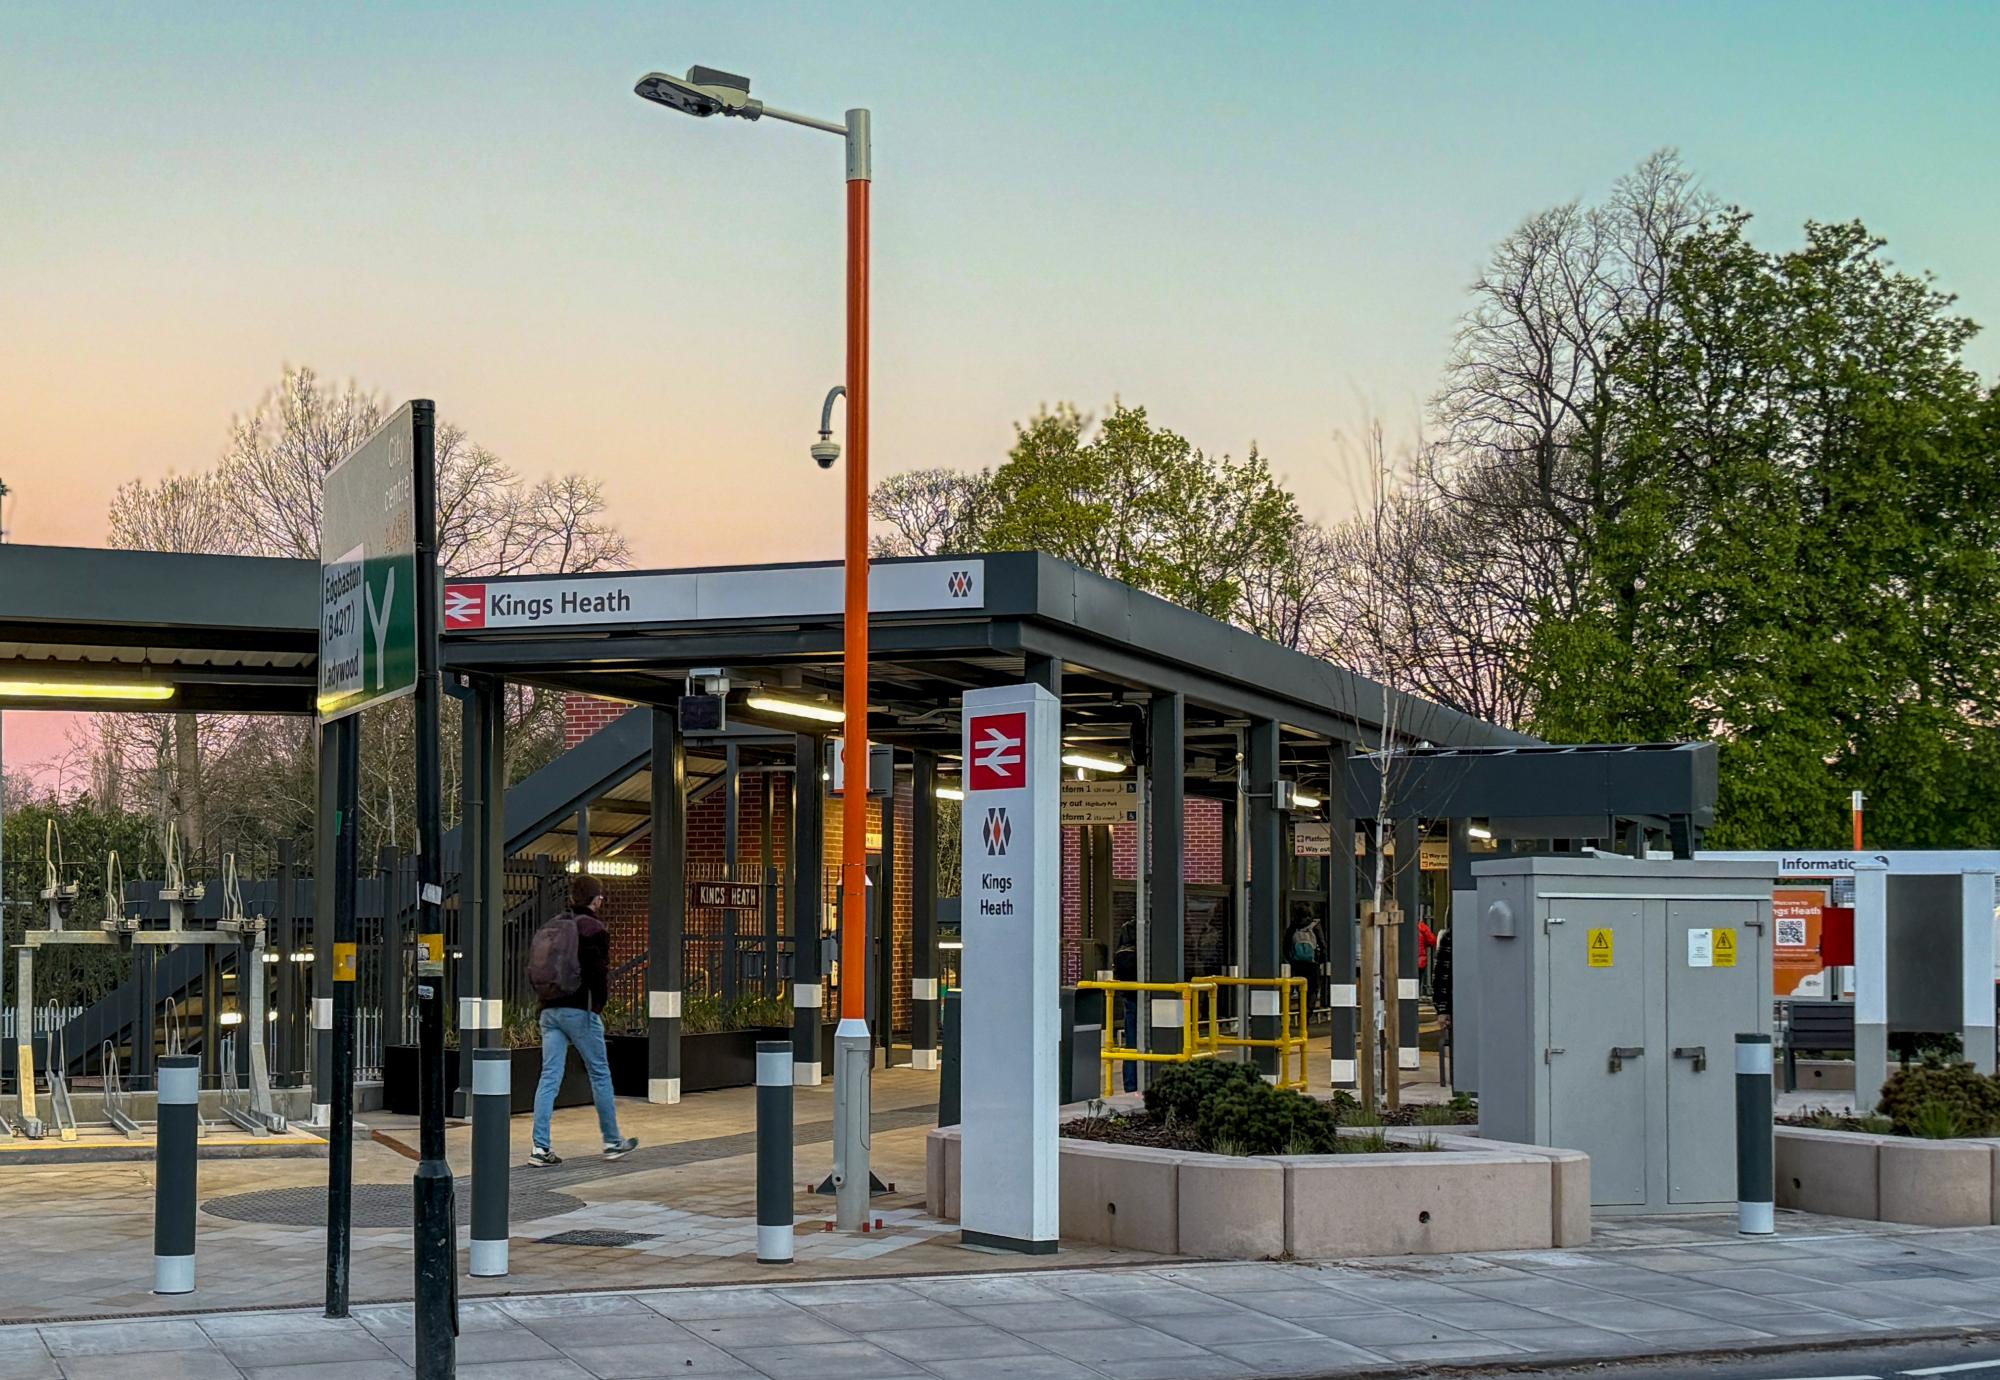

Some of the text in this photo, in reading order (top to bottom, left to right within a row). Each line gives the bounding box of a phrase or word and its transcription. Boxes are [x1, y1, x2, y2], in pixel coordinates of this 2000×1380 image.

[384, 475, 410, 512] centre
[325, 564, 362, 605] Edgbaston
[491, 589, 631, 621] Kings Heath
[324, 599, 356, 646] (B4217)
[324, 648, 359, 690] Ladywood
[1062, 785, 1084, 793] tform
[1062, 813, 1084, 821] tform
[1782, 857, 1857, 870] Informatio
[982, 873, 1012, 893] Kings
[731, 887, 756, 905] HEATH
[981, 899, 1013, 916] Heath
[1790, 905, 1821, 915] Heath
